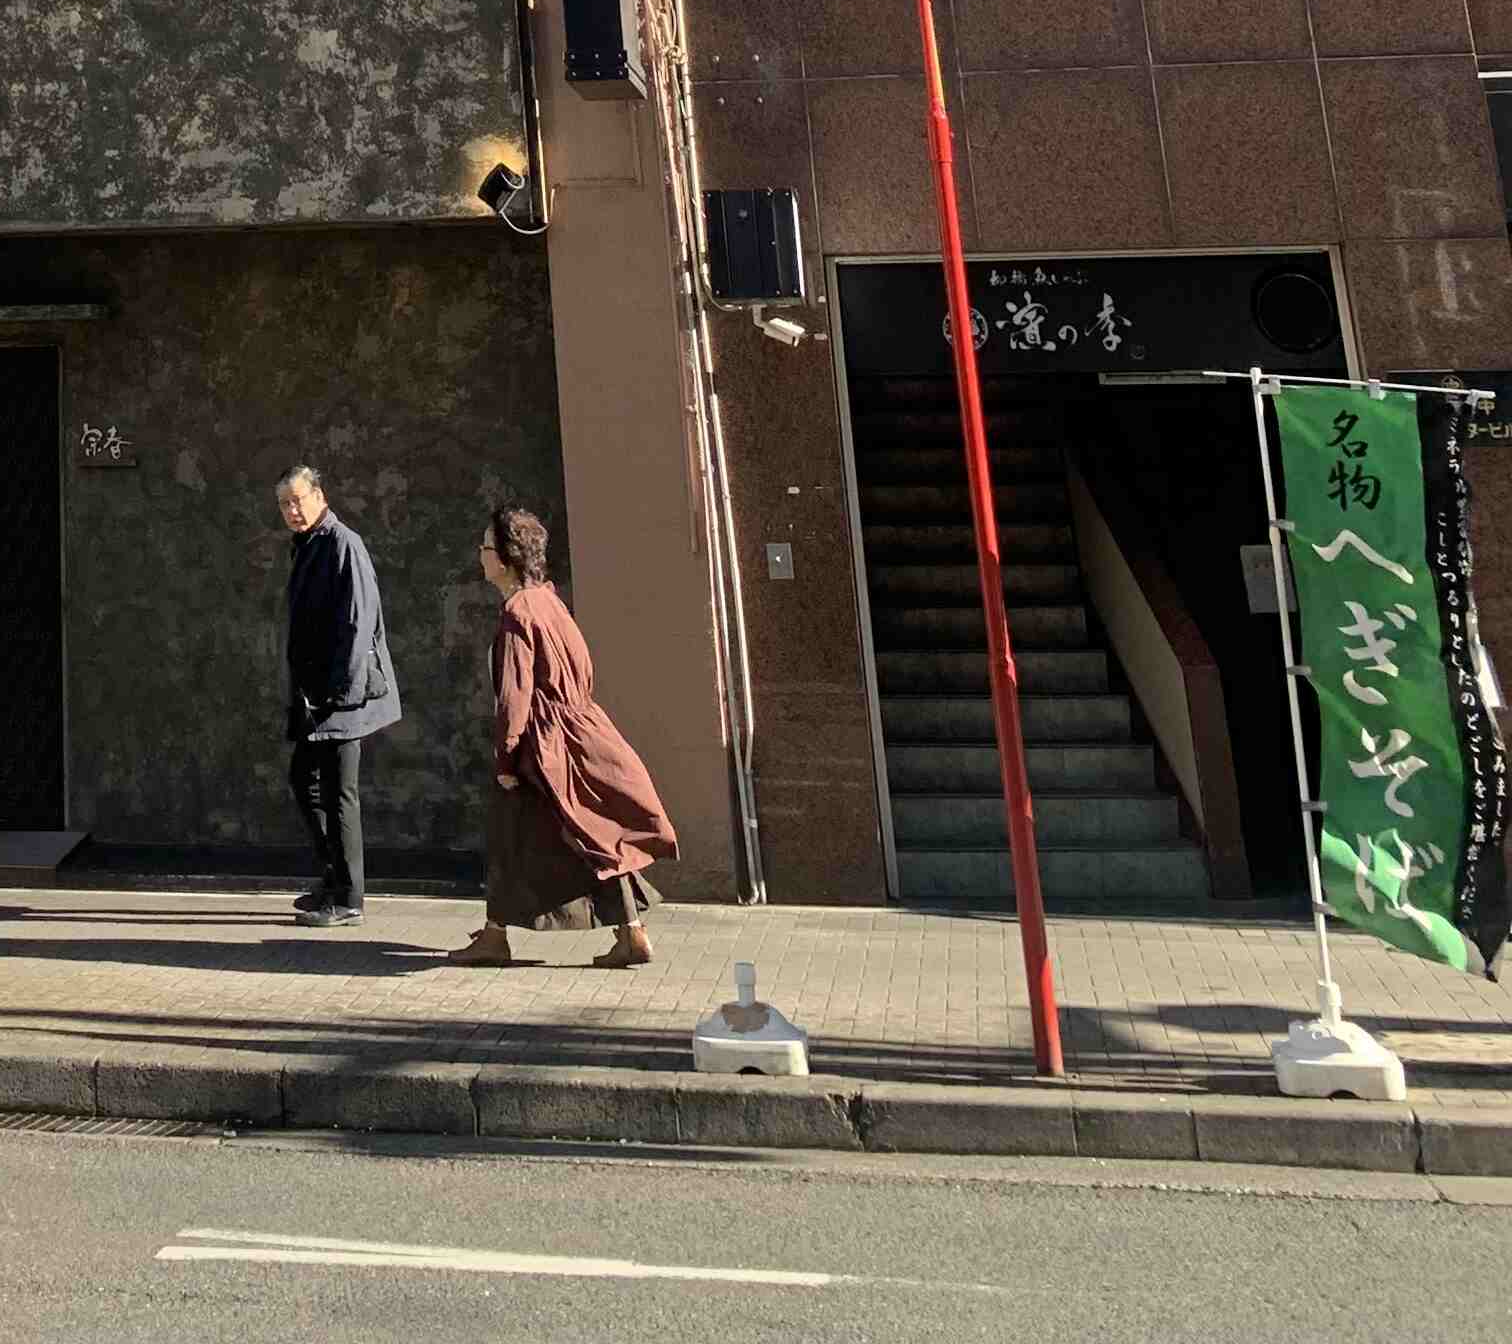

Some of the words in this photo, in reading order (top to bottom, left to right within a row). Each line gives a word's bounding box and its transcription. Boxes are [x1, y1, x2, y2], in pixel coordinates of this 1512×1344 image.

[1325, 409, 1382, 513] 名物
[1311, 528, 1445, 922] へぎそば
